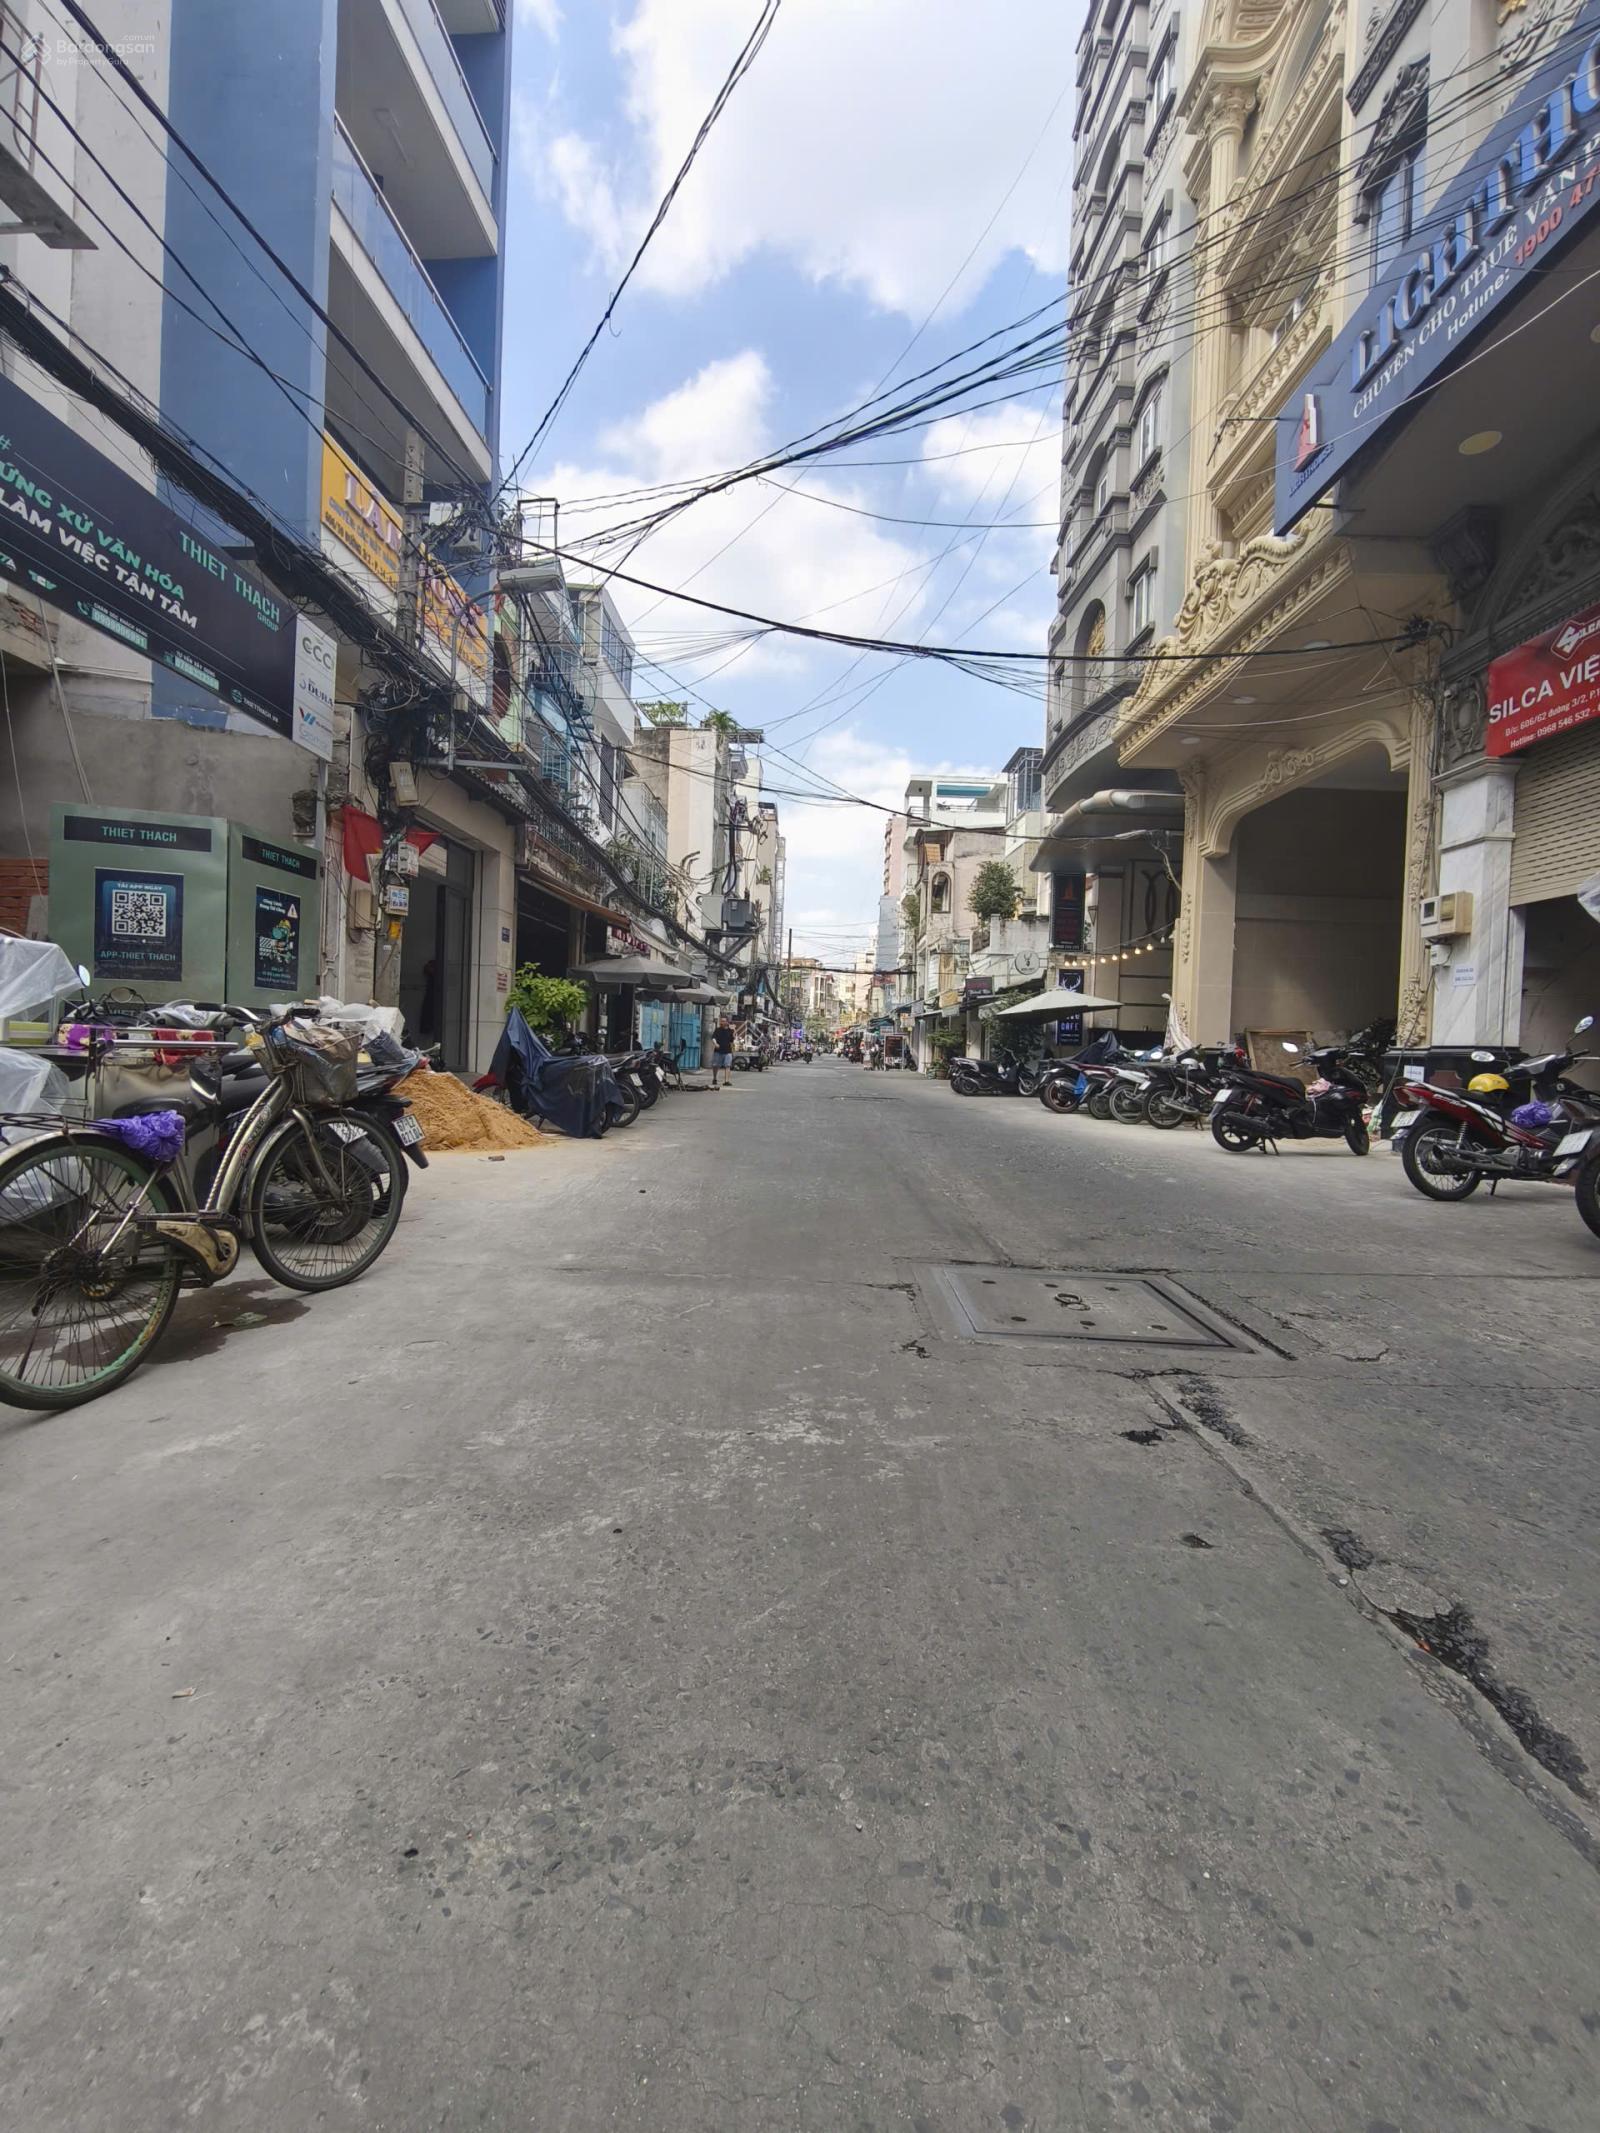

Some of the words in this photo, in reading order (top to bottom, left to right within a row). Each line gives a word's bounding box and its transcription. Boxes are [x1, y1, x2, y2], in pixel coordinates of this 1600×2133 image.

[1447, 268, 1510, 341] Hotline:
[1514, 207, 1562, 265] 1900
[1353, 338, 1416, 419] CHUYÊN
[1418, 296, 1457, 345] CHO
[1460, 224, 1518, 300] THUÊ
[57, 503, 94, 534] XỬ
[97, 528, 141, 569] VĂN
[144, 563, 184, 600] HÓA
[59, 527, 110, 572] VIỆC
[115, 564, 155, 600] TẬN
[160, 594, 197, 629] TÂM
[180, 531, 228, 581] THIET
[233, 573, 280, 623] THACH
[257, 611, 279, 632] GROUP
[1490, 680, 1553, 723] SILCA
[1560, 654, 1600, 689] VIỆ
[1510, 733, 1537, 749] Hotline:
[1537, 722, 1557, 737] 0968
[1558, 715, 1573, 729] 546
[1575, 708, 1591, 721] 532
[102, 826, 135, 839] THIET
[139, 829, 177, 842] THACH
[262, 848, 280, 863] THIET
[281, 855, 300, 869] THACH
[149, 953, 176, 961] THACH
